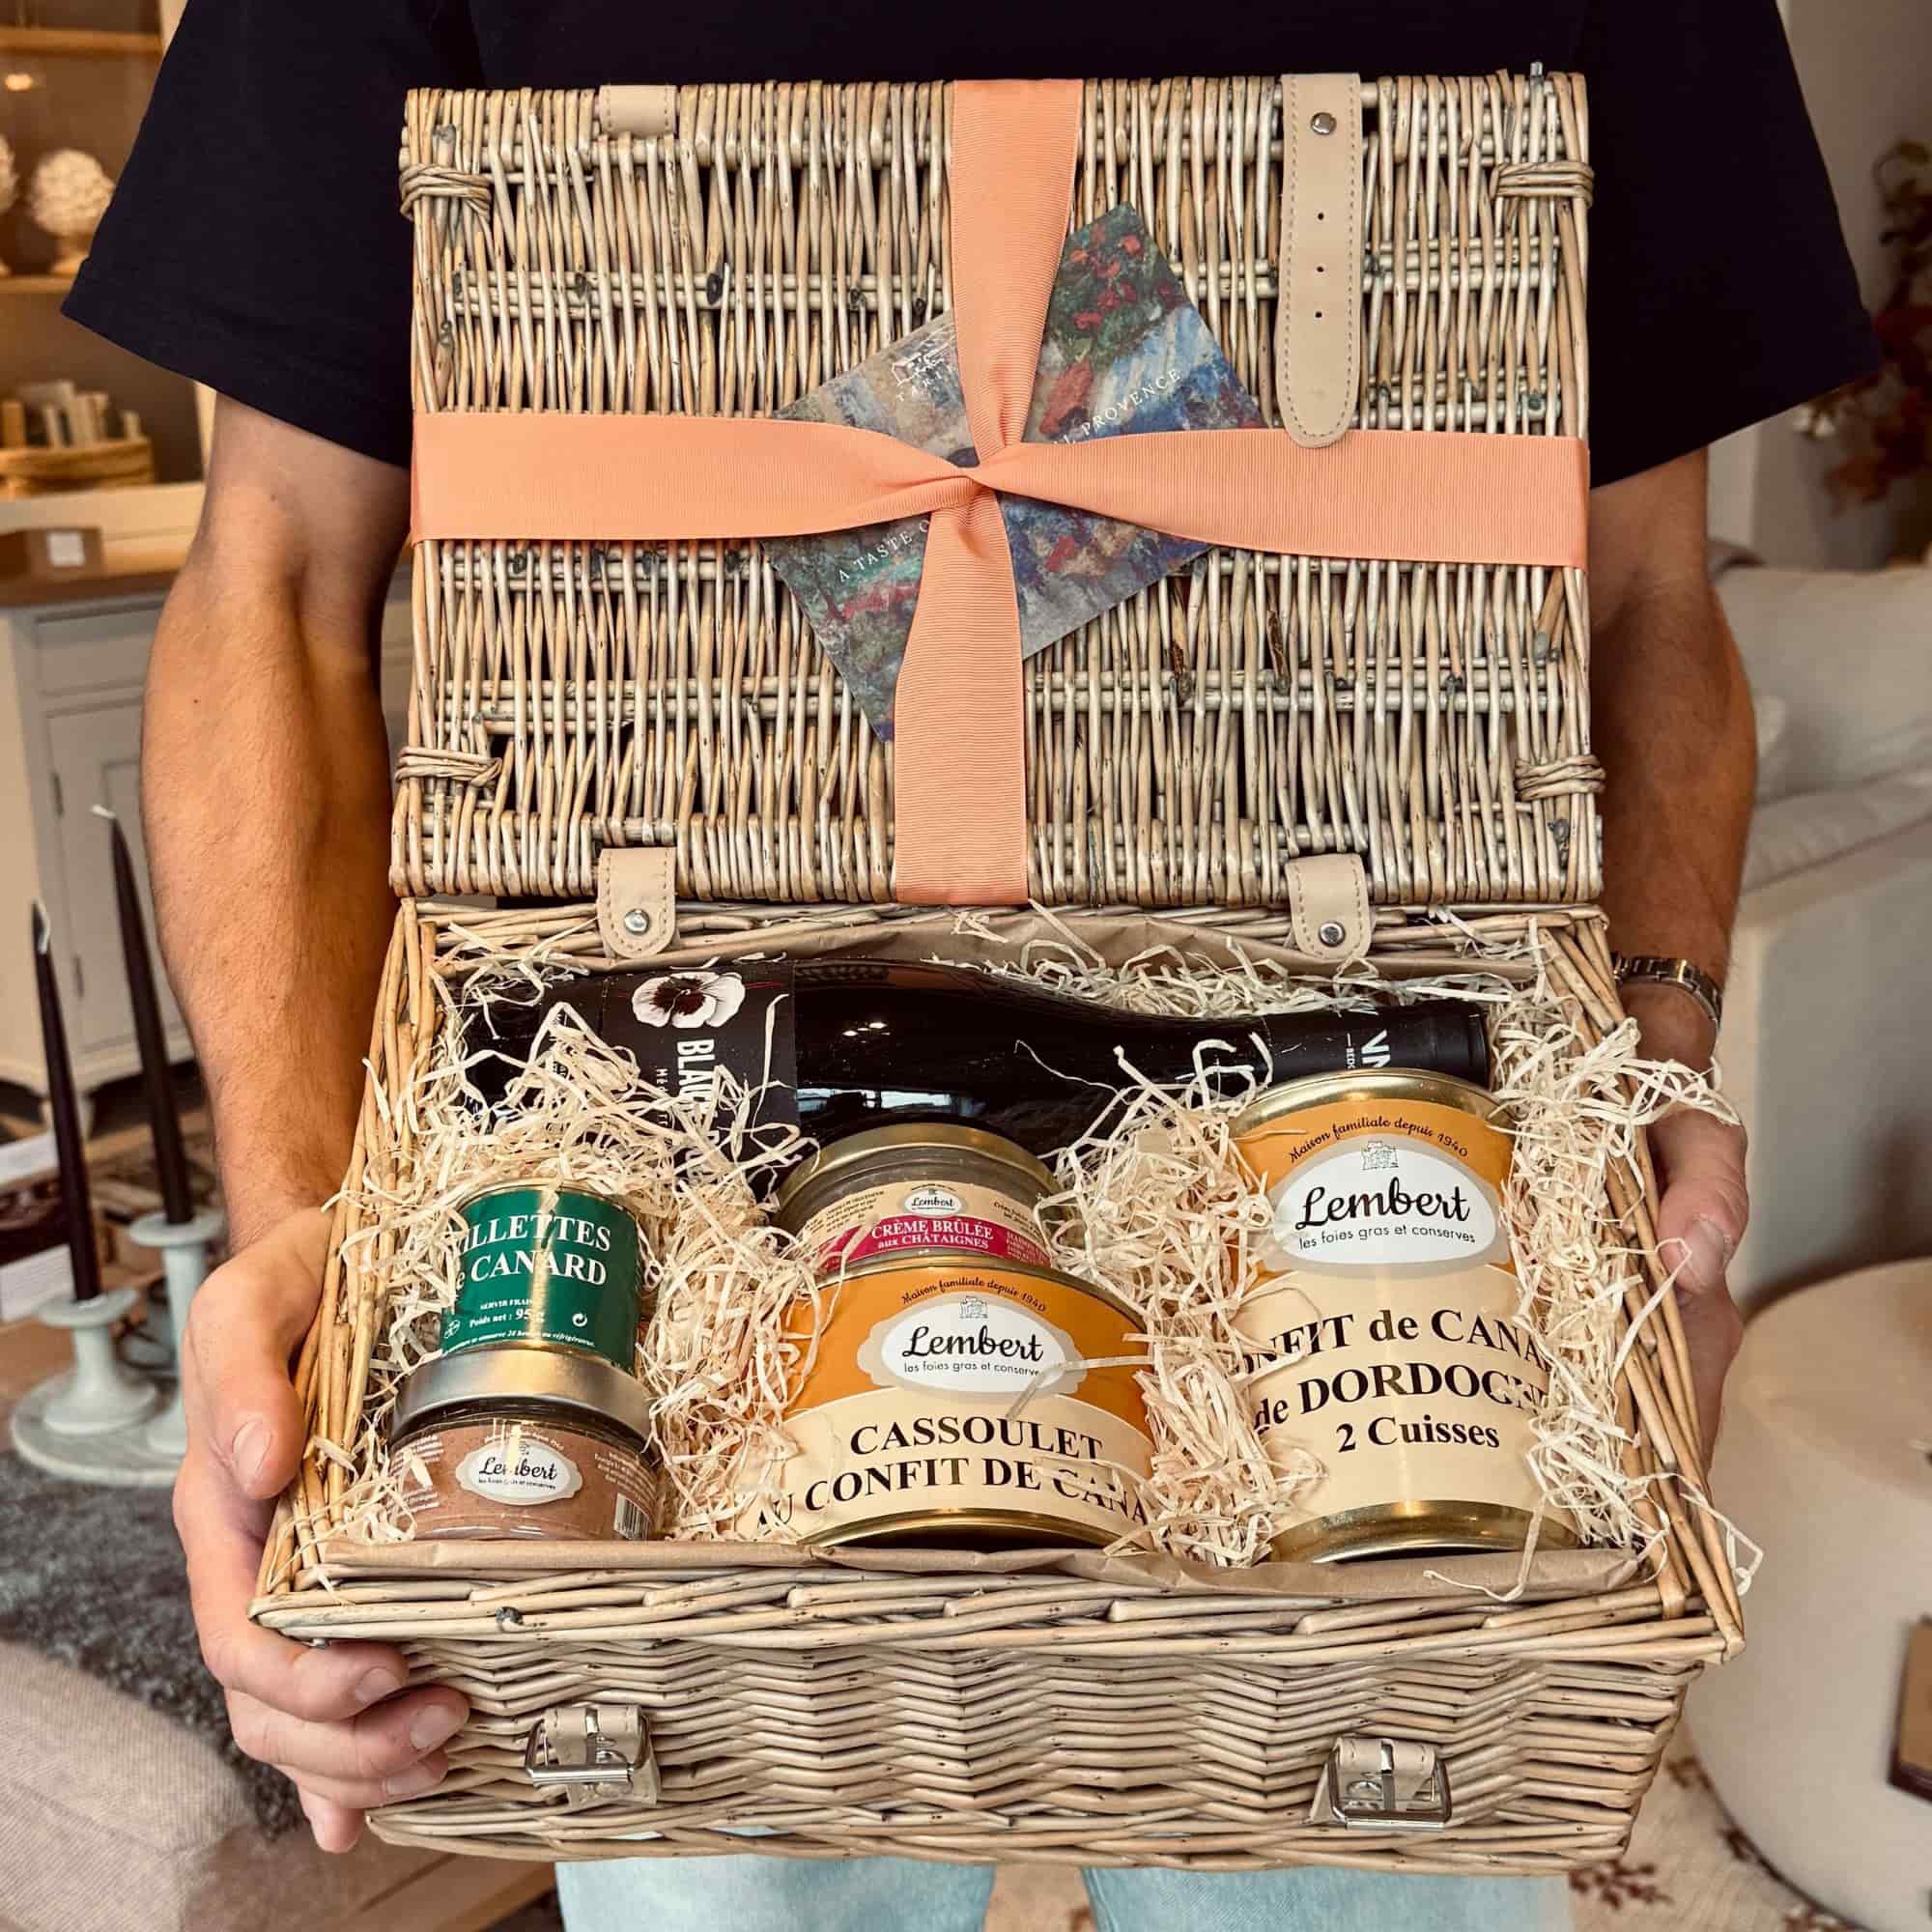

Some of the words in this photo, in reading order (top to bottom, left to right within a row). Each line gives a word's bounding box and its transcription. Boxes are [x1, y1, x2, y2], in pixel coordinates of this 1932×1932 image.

[1081, 368, 1181, 435] PROVENCE
[838, 569, 850, 582] A
[853, 531, 913, 571] TASTE
[1290, 1130, 1331, 1164] Maison
[1331, 1116, 1391, 1139] familiale
[1394, 1117, 1434, 1137] depuis
[1437, 1133, 1469, 1159] 1940
[911, 1196, 956, 1208] Lembert
[1294, 1176, 1471, 1232] Lembert
[458, 1214, 611, 1253] ILLETTES
[871, 1217, 929, 1239] CRÈME
[932, 1216, 995, 1241] BRÛLÉE
[877, 1237, 898, 1249] aux
[901, 1230, 990, 1250] CHÂTAIGNES
[1298, 1236, 1318, 1250] les
[1321, 1229, 1354, 1244] foies
[1358, 1227, 1390, 1240] gras
[1394, 1225, 1407, 1236] et
[1411, 1226, 1476, 1244] conserves
[456, 1270, 467, 1292] e
[470, 1249, 608, 1287] CANARD
[900, 1284, 938, 1305] Maison
[939, 1276, 985, 1294] familiale
[987, 1278, 1019, 1296] depuis
[1021, 1292, 1047, 1313] 1940
[901, 1324, 1044, 1362] Lembert
[1368, 1309, 1420, 1343] de
[1431, 1309, 1552, 1374] CANA
[903, 1362, 919, 1374] les
[923, 1360, 950, 1372] foies
[952, 1361, 978, 1373] gras
[981, 1361, 991, 1371] et
[994, 1363, 1040, 1377] conserve
[1254, 1399, 1290, 1435] de
[1336, 1423, 1357, 1453] 2
[1367, 1414, 1500, 1449] Cuisses
[849, 1415, 1103, 1460] CASSOULET
[805, 1457, 970, 1512] CONFIT
[981, 1457, 1042, 1491] DE
